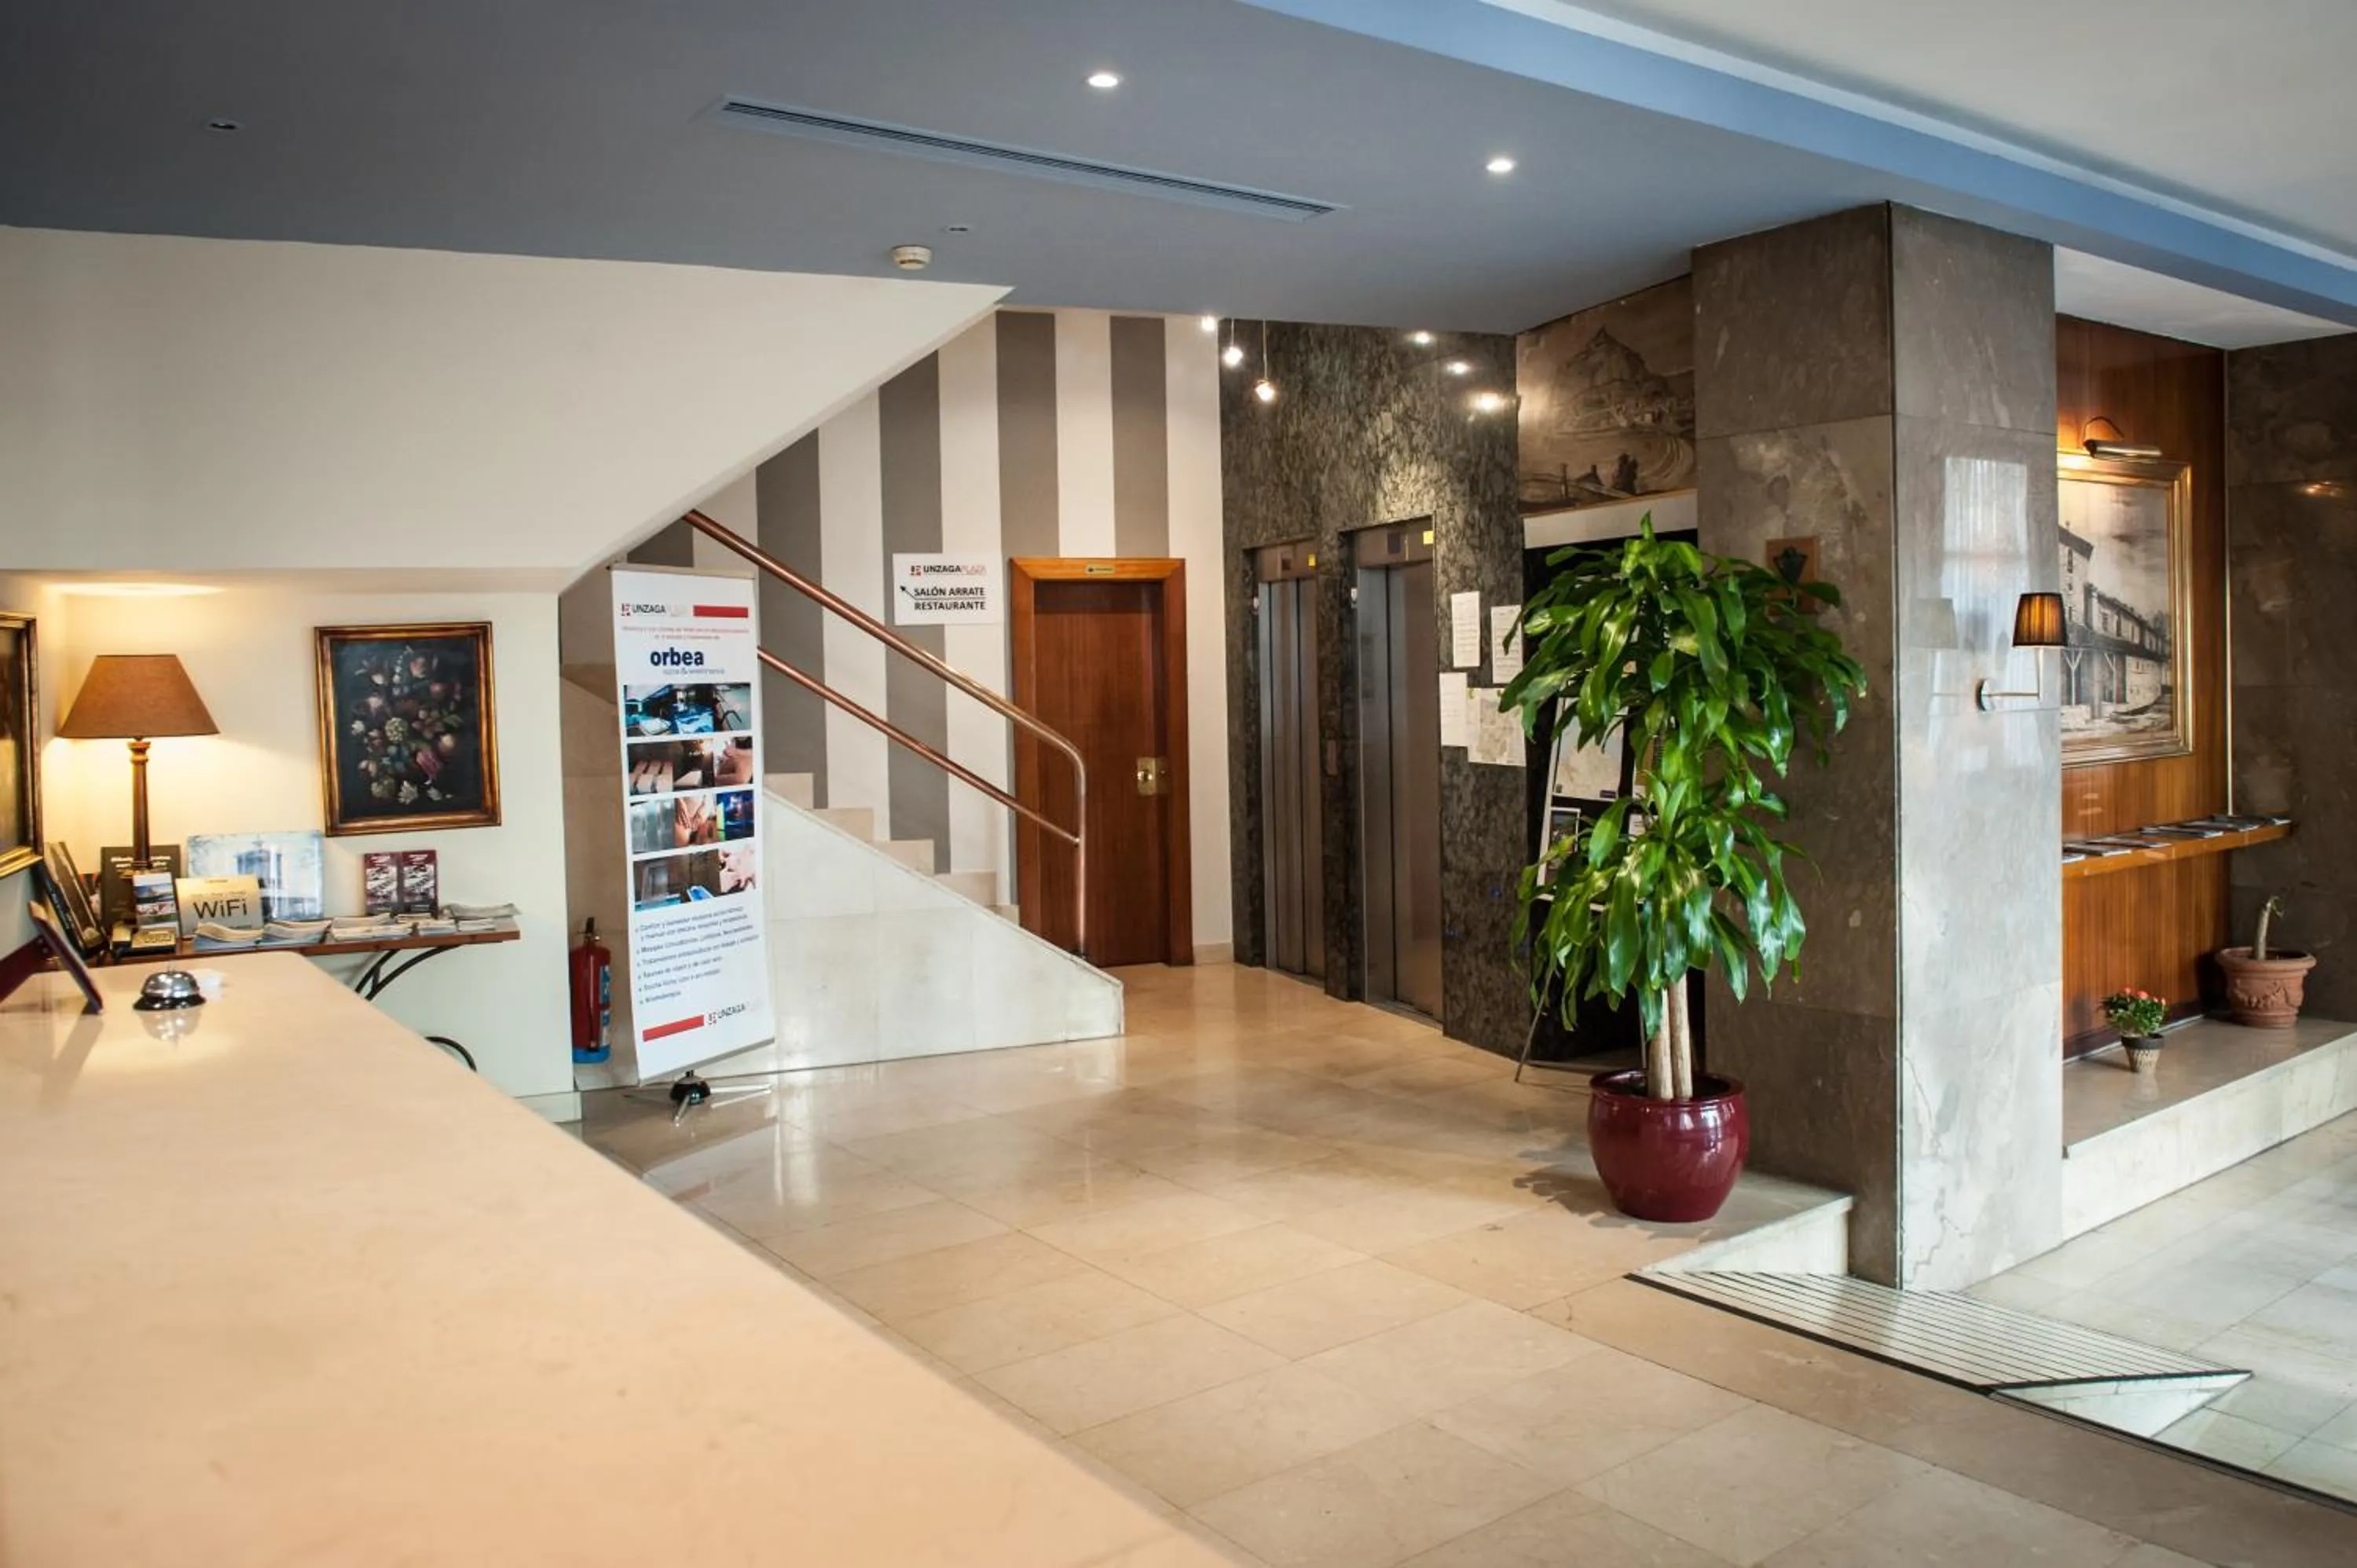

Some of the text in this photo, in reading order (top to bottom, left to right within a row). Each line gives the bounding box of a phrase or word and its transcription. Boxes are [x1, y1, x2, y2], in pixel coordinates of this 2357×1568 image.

[914, 586, 985, 596] SALÓN ARRATE
[914, 601, 986, 610] RESTAURANTE
[650, 647, 704, 666] orbea
[192, 898, 247, 919] WiFi
